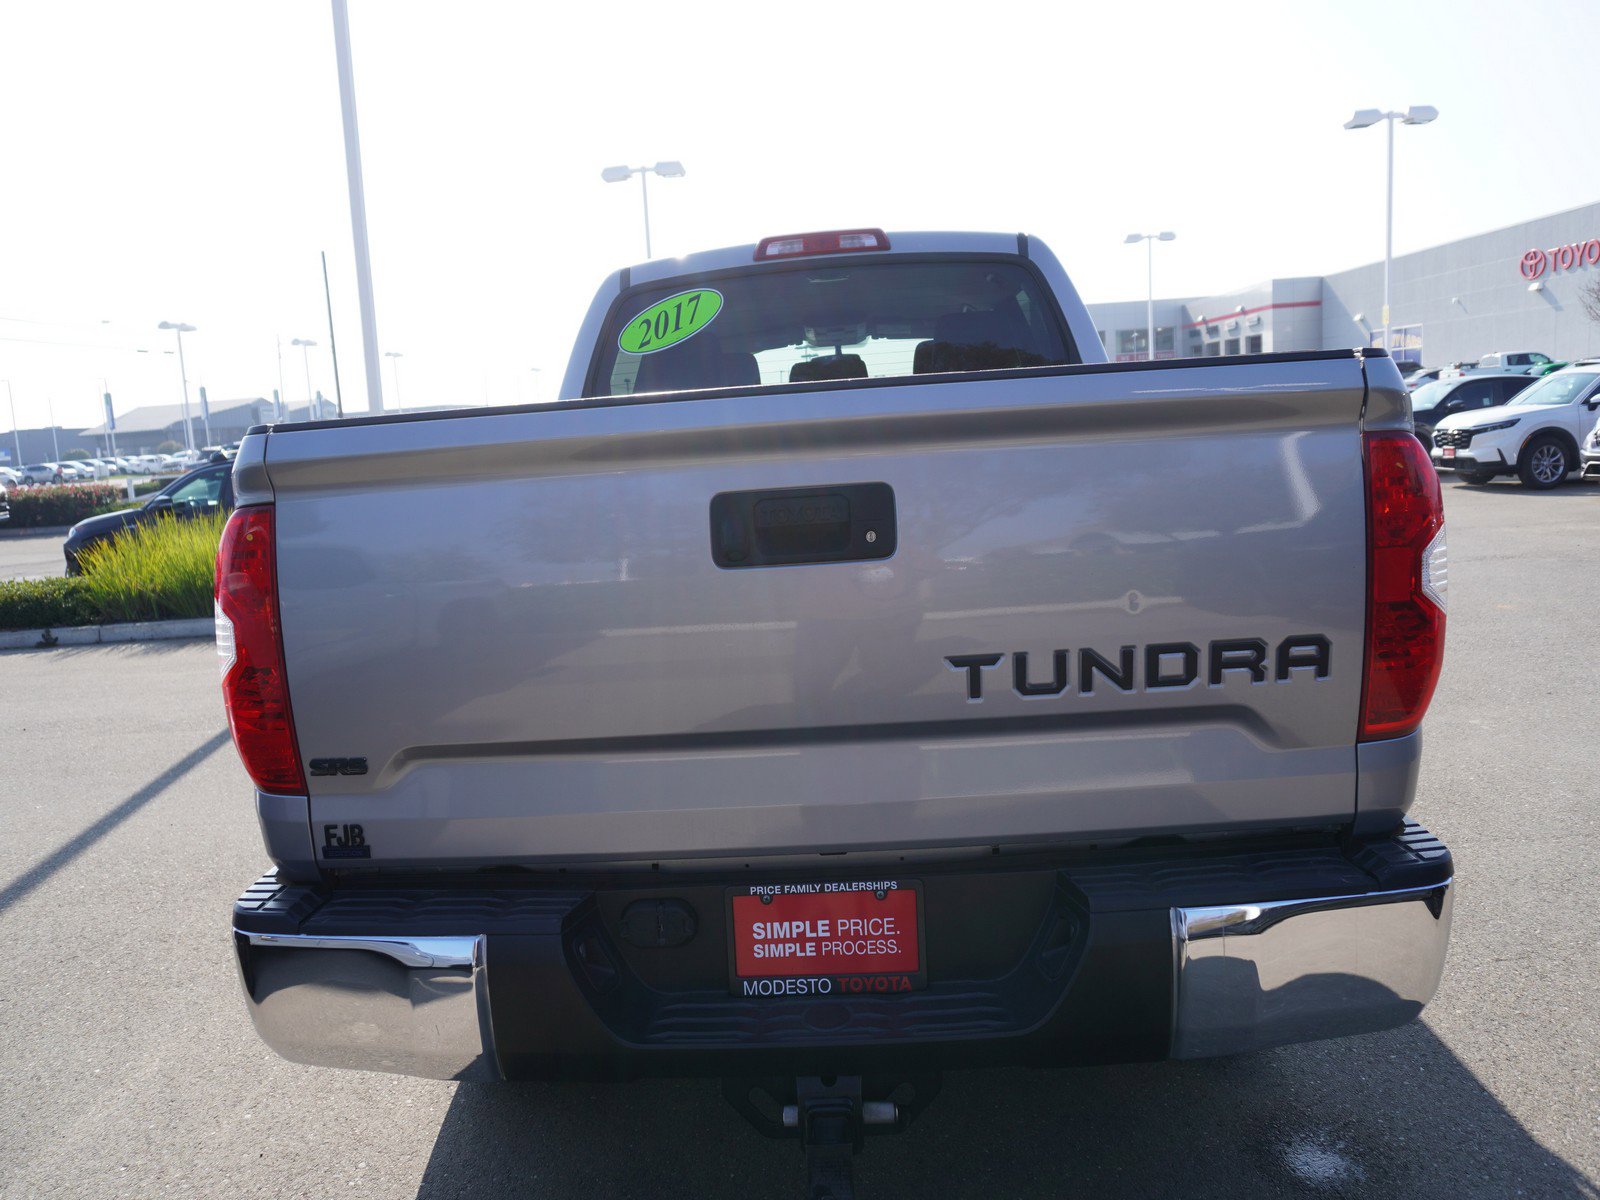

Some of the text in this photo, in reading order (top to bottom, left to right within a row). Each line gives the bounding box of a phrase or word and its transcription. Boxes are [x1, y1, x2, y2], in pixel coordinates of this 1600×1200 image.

[1547, 238, 1600, 272] TOYO
[637, 293, 702, 350] 2017
[942, 633, 1333, 704] TUNDRA
[324, 824, 366, 847] FJB
[750, 881, 898, 895] PRICE FAMILY DEALERSHIPS
[752, 917, 901, 940] SIMPLE PRICE.
[753, 939, 902, 958] SIMPLE PROCESS.
[743, 976, 912, 996] MODESTO TOYOTA
